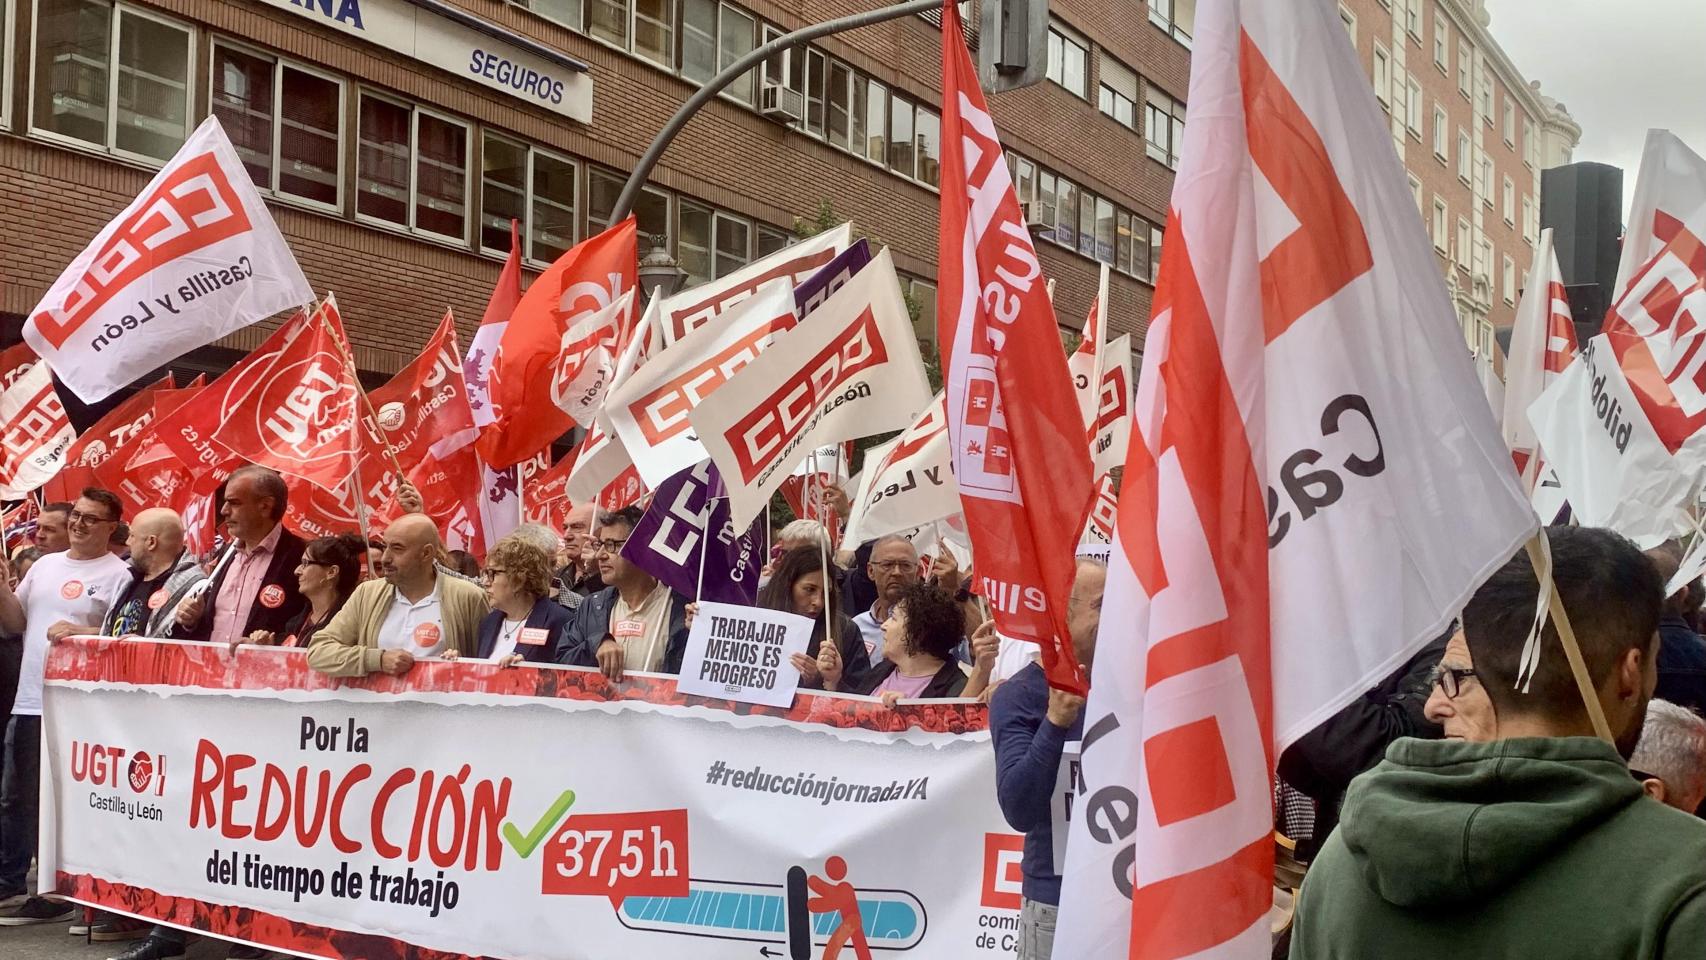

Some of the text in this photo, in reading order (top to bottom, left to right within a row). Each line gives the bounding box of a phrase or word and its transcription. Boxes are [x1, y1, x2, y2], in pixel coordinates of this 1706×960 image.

[470, 49, 564, 104] SEGUROS
[265, 362, 338, 445] UGT
[743, 323, 873, 466] CCOO
[824, 382, 872, 414] León
[711, 616, 787, 646] TRABAJAR
[705, 639, 782, 668] MENOS ES
[700, 660, 777, 690] PROGRESO
[300, 716, 369, 753] Por la
[71, 741, 126, 788] UGT
[706, 761, 929, 806] #reducciónjornadaYA
[89, 792, 163, 821] Castilla y León
[189, 738, 512, 871] REDUCCIÓN
[206, 850, 460, 918] del tiempo de trabajo
[976, 933, 996, 950] de
